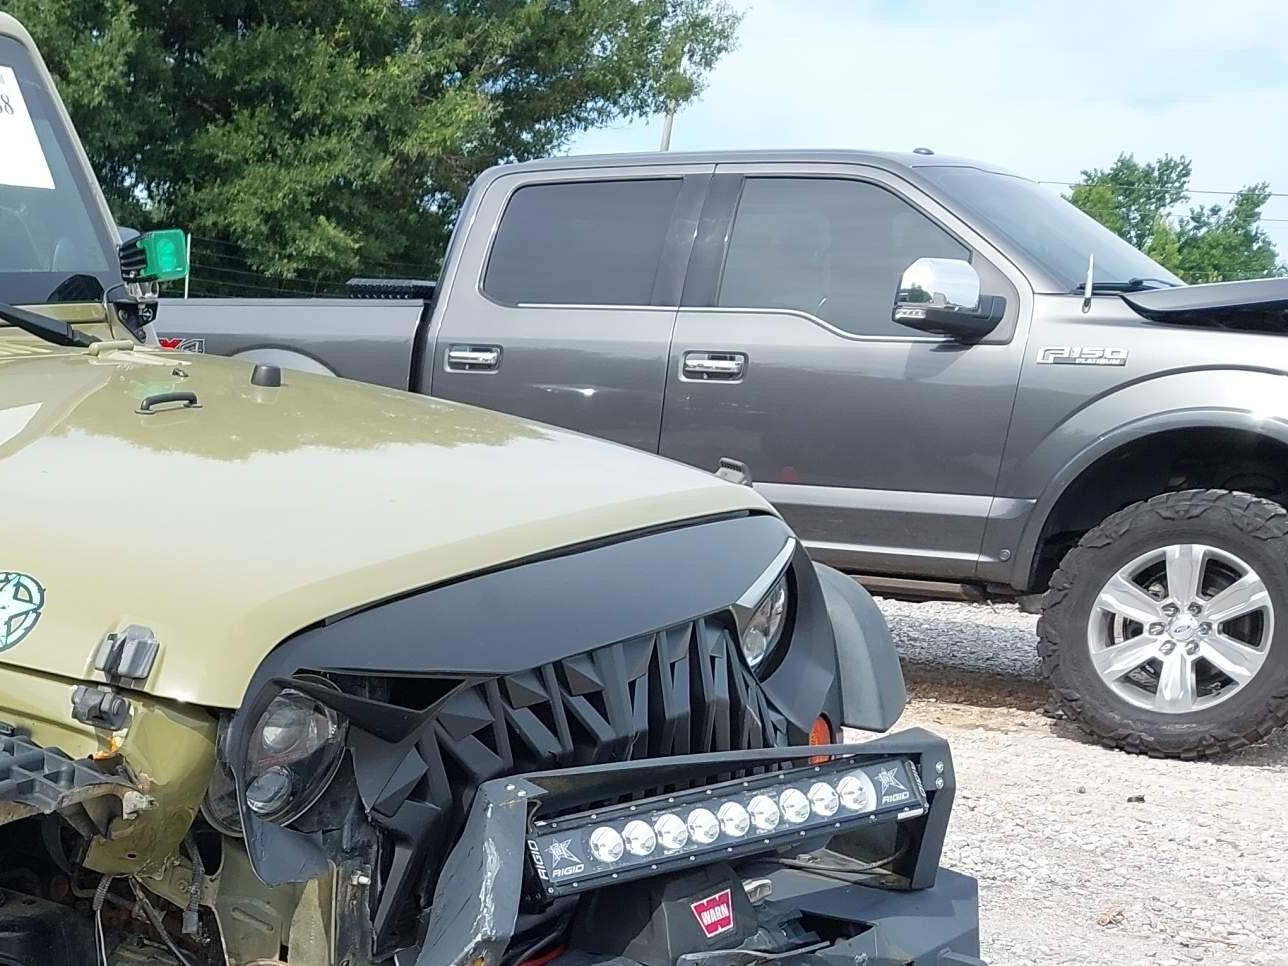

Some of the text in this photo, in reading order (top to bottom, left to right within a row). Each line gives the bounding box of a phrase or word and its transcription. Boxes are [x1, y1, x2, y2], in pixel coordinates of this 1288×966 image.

[881, 791, 910, 805] RIGID
[527, 839, 549, 880] RIGID
[552, 863, 585, 878] RIGID
[700, 903, 730, 926] WARN
